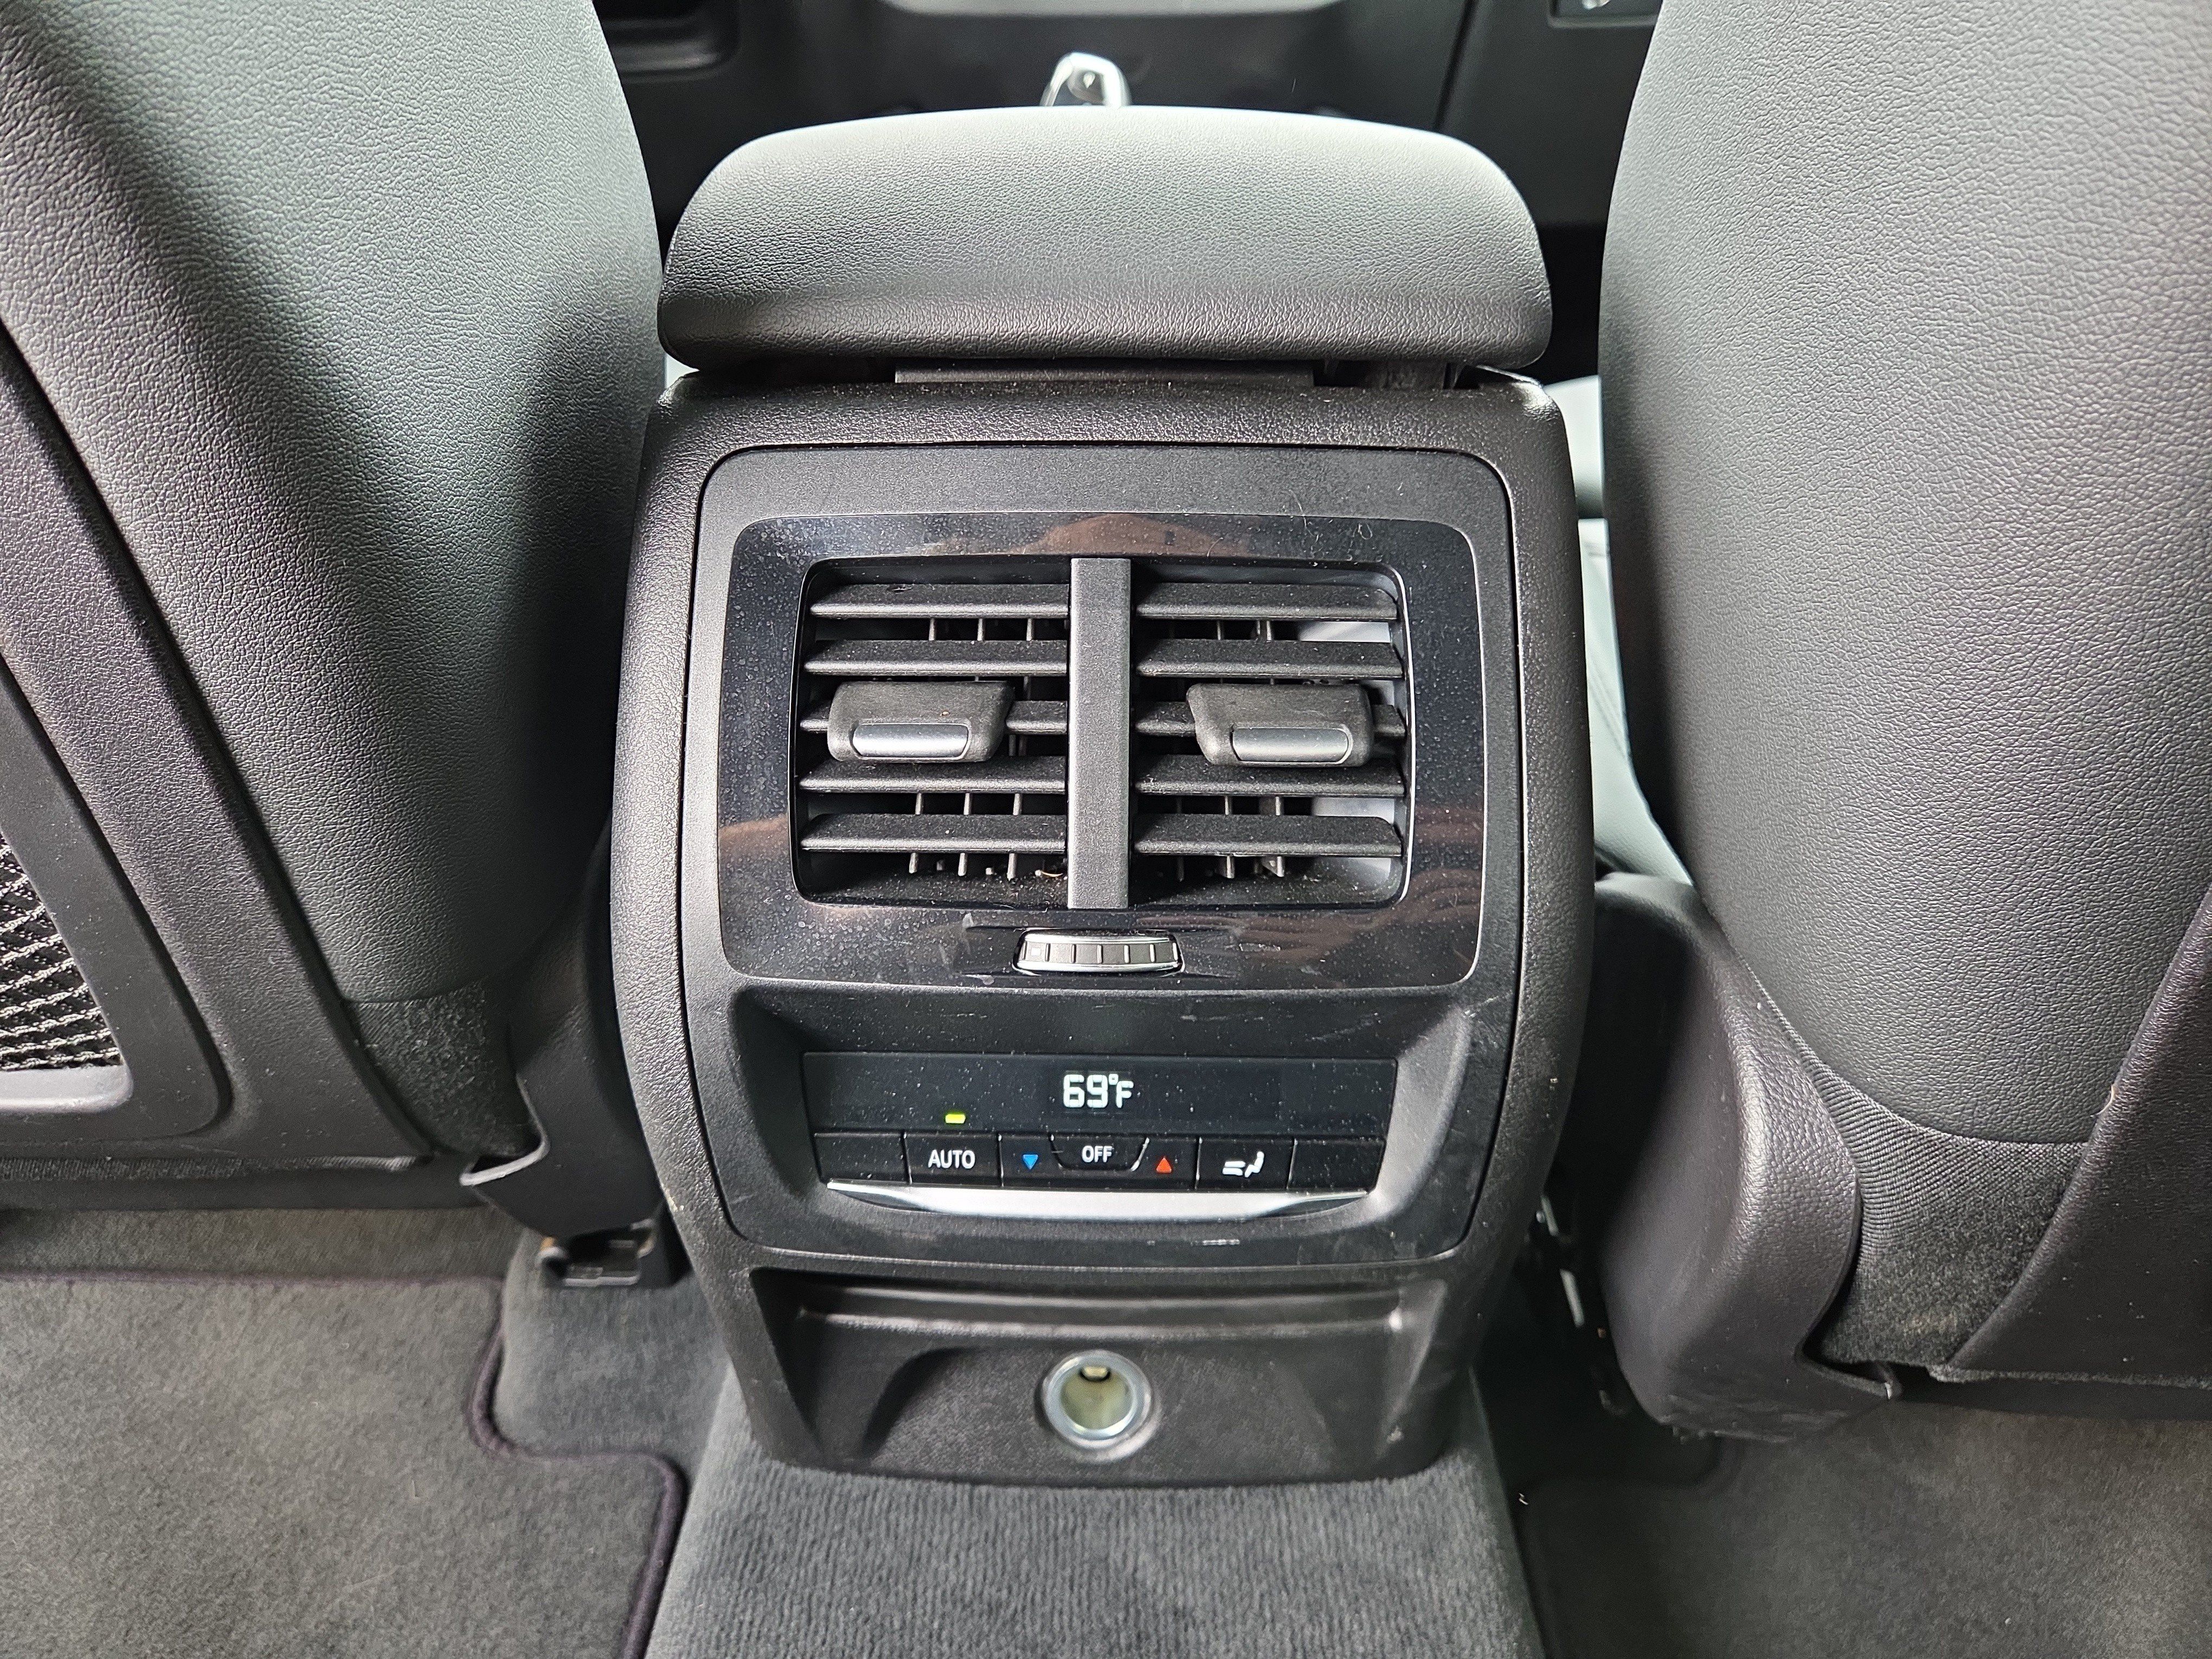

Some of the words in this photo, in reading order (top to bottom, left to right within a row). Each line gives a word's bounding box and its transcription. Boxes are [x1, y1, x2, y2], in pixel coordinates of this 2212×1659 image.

[1063, 1073, 1134, 1108] 69°F
[928, 1149, 975, 1169] AUTO
[1082, 1145, 1113, 1163] OFF
